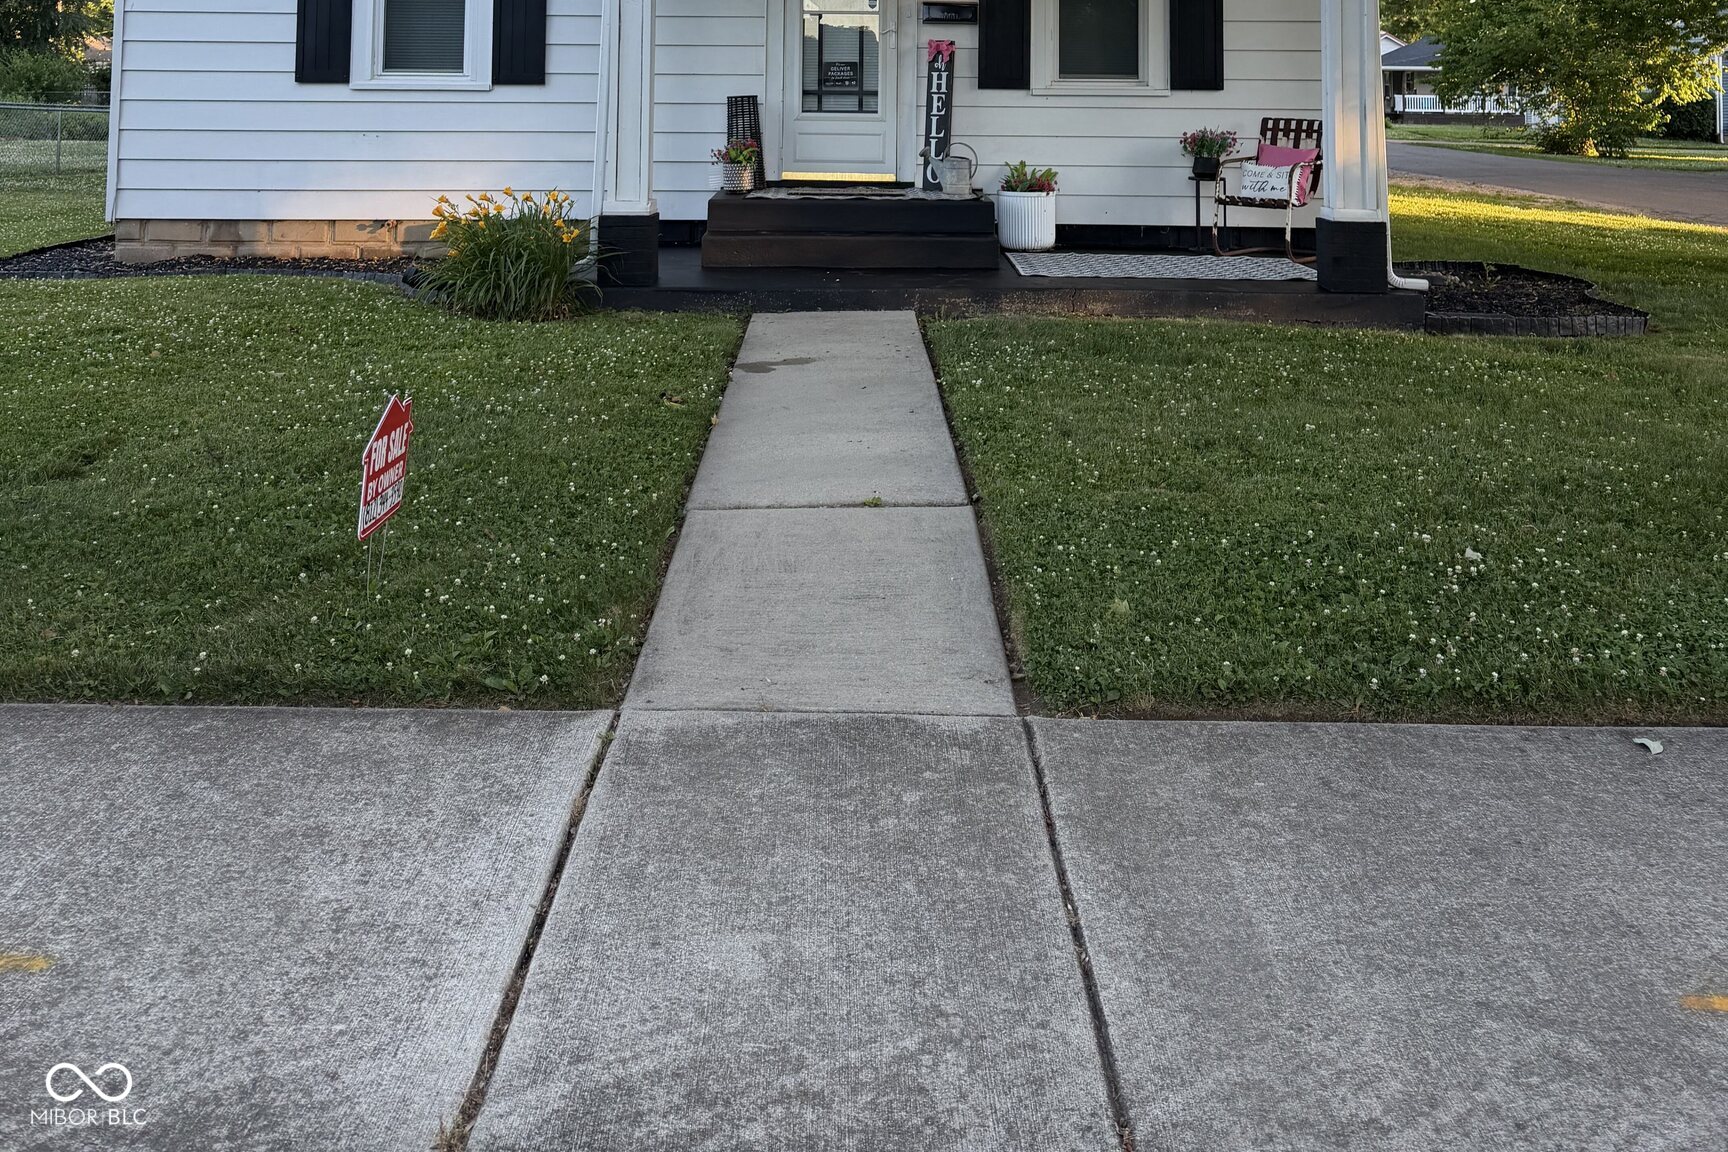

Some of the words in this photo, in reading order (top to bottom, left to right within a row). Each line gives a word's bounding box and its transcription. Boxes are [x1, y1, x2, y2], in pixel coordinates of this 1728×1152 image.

[1241, 180, 1269, 193] with
[1242, 169, 1265, 179] COME
[1266, 171, 1273, 179] &
[1275, 171, 1289, 180] SIT
[369, 434, 387, 476] FOR
[387, 422, 409, 462] SALE
[367, 480, 378, 501] BY
[378, 460, 404, 494] OWNER
